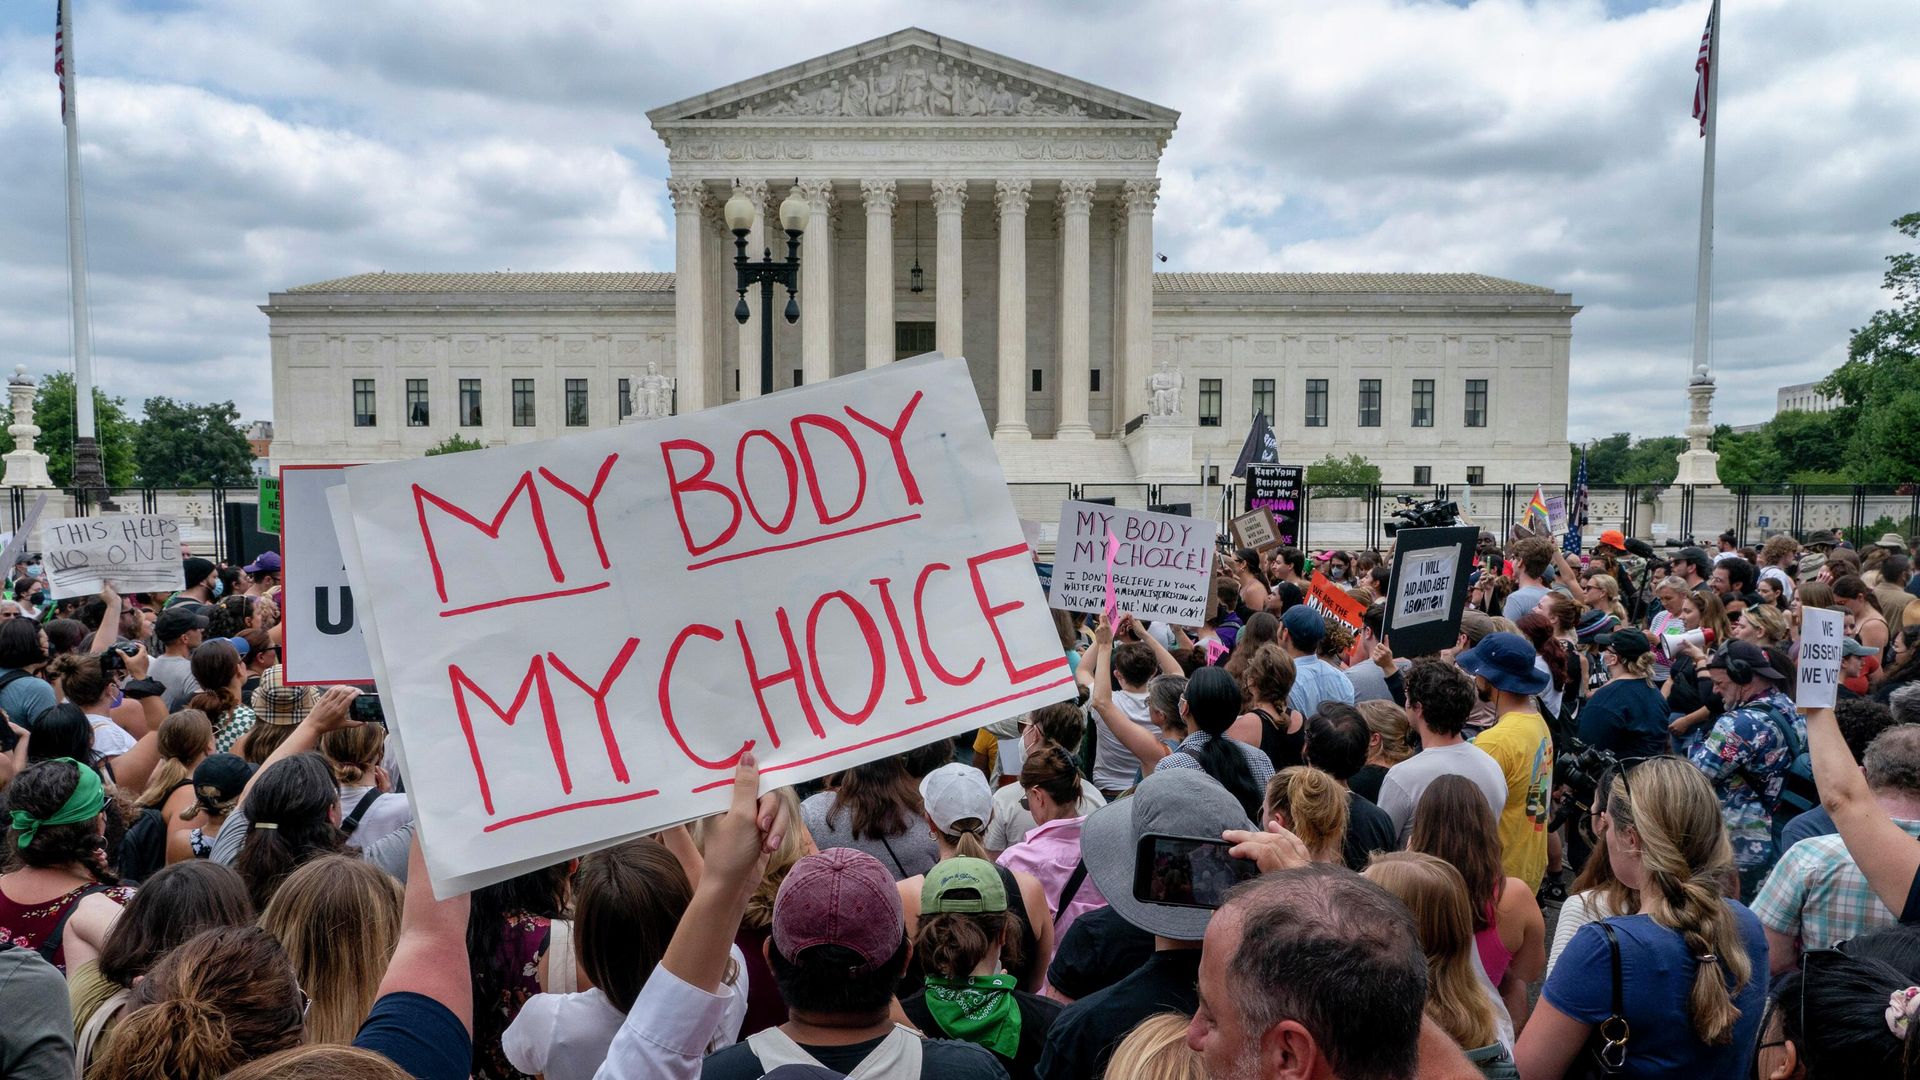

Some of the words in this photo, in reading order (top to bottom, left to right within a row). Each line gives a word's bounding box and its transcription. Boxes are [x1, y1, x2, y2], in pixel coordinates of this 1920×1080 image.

[411, 452, 619, 604] MY
[661, 390, 925, 557] BODY
[1251, 498, 1295, 511] VAGINA
[51, 521, 108, 545] THIS
[122, 518, 178, 542] HELPS
[1076, 511, 1114, 536] MY
[1125, 516, 1192, 546] BODY
[50, 549, 89, 570] NO
[107, 538, 176, 565] ONE
[1073, 540, 1110, 563] MY
[1113, 542, 1208, 576] CHOICE!
[1420, 562, 1424, 576] I
[1425, 560, 1440, 575] WILL
[1066, 571, 1075, 580] I
[1082, 571, 1107, 584] DON'T
[1113, 574, 1155, 587] BELIEVE
[1157, 579, 1171, 588] IN
[1174, 581, 1197, 591] YOUR
[1404, 582, 1417, 597] AID
[1417, 579, 1432, 594] AND
[1432, 576, 1450, 592] ABET
[1061, 593, 1078, 607] YOU
[1122, 599, 1139, 612] ME!
[1142, 602, 1159, 613] NOR
[1161, 605, 1178, 614] CAN
[1312, 585, 1323, 598] WE
[1323, 594, 1334, 608] ARE
[1335, 604, 1349, 617] THE
[1404, 595, 1444, 614] ABORTION
[1822, 620, 1834, 637] WE
[1802, 643, 1838, 660] DISSENT
[448, 637, 641, 817] MY
[658, 542, 1069, 770] CHOICE
[1801, 667, 1821, 684] WE
